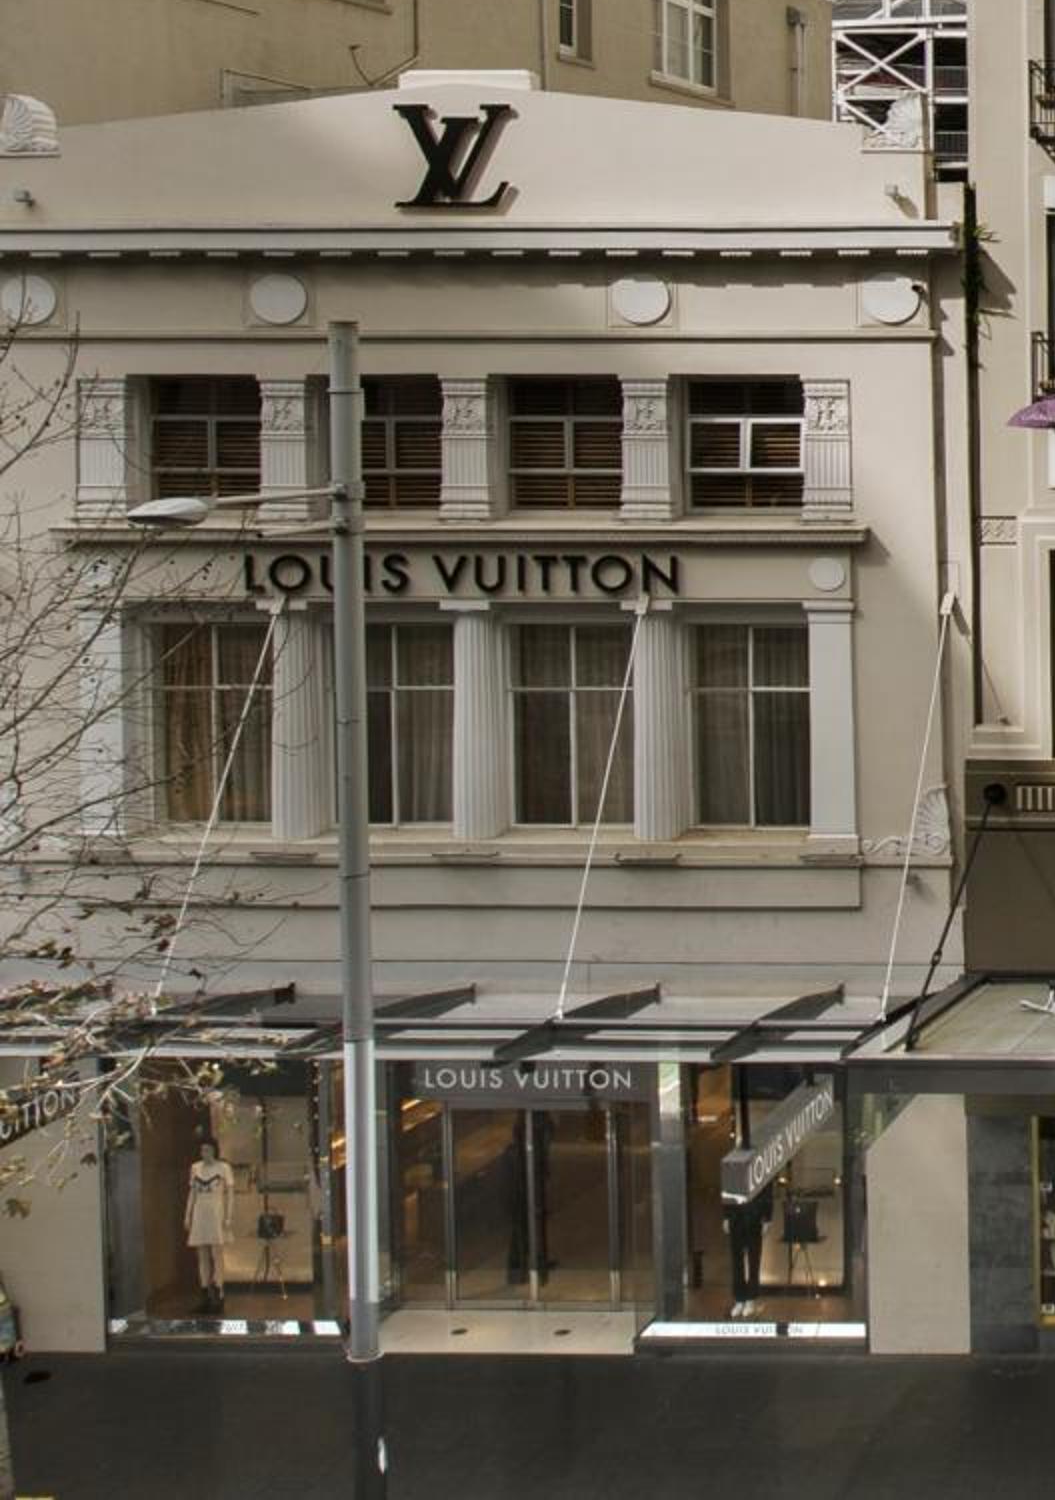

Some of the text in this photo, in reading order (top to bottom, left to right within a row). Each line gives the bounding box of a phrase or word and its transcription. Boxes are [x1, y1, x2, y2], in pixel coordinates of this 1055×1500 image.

[433, 554, 679, 594] VUITTON
[425, 1068, 632, 1089] LOUIS VUITTON
[748, 1091, 833, 1192] LOUIS VUITTON
